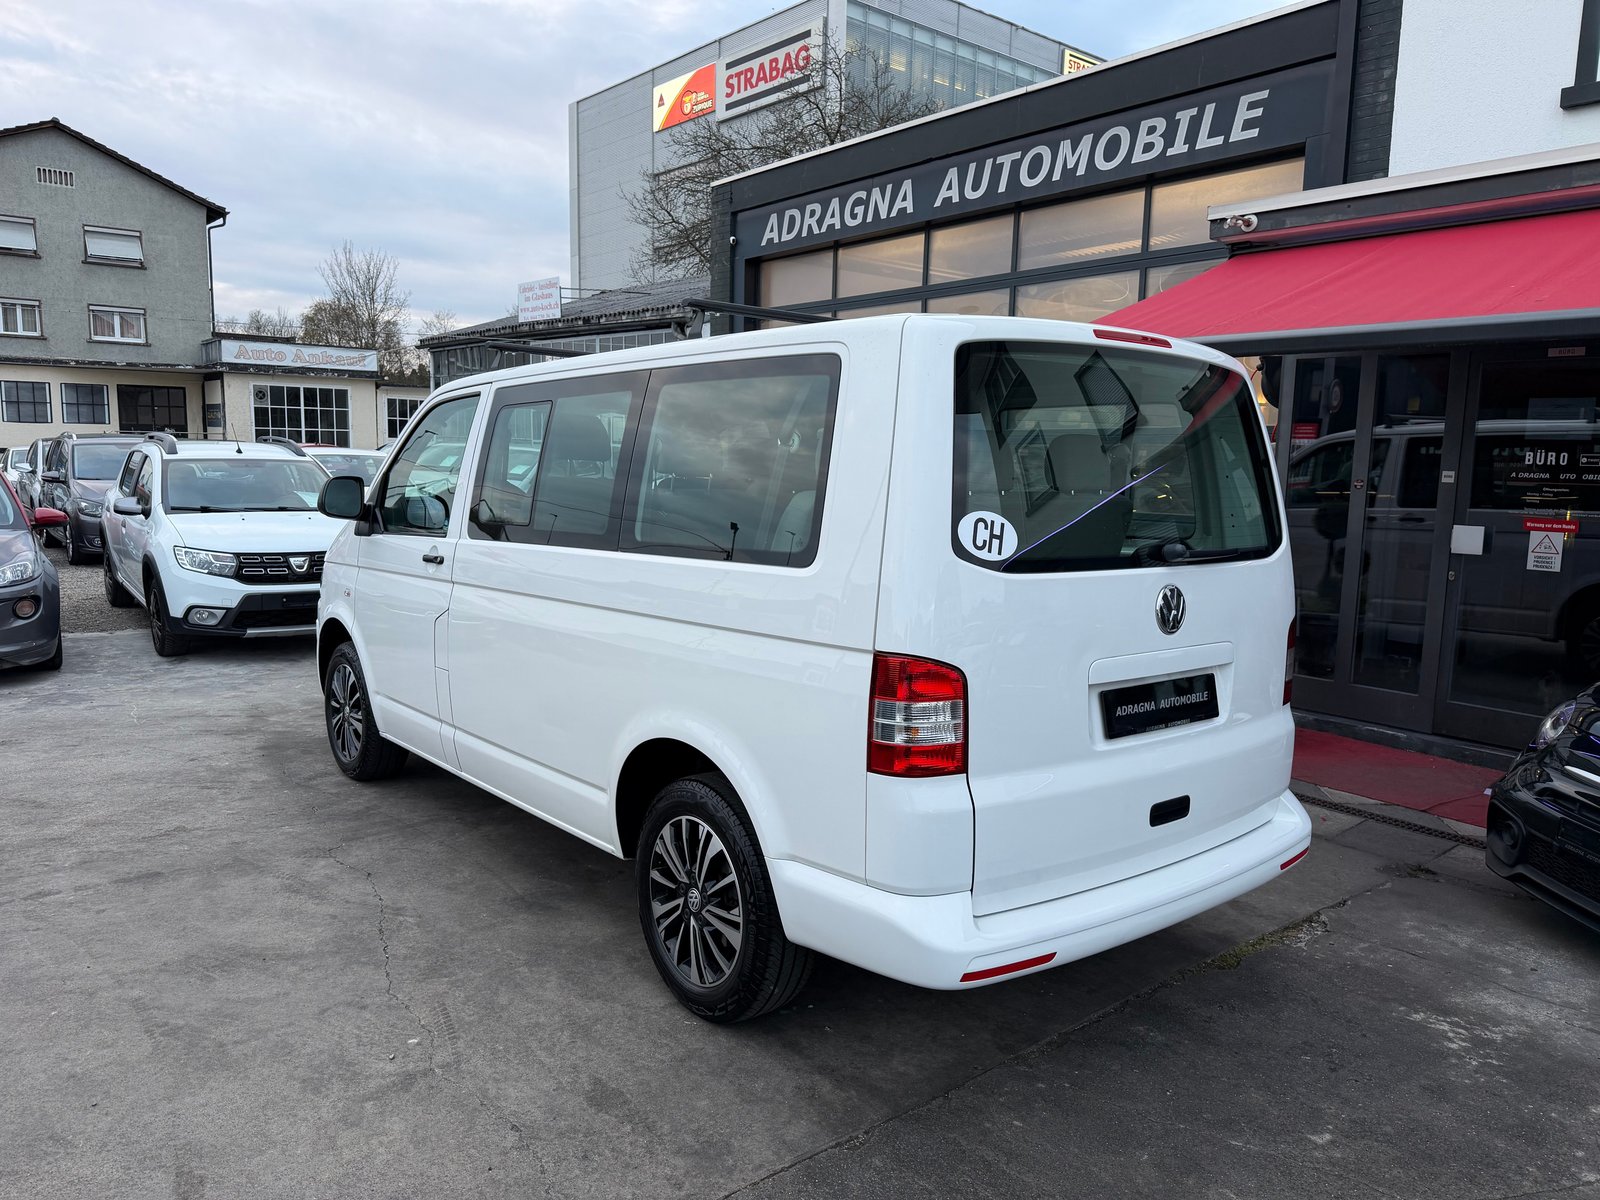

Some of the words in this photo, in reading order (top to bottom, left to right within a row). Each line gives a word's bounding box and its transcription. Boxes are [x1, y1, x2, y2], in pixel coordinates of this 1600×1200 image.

[725, 44, 810, 98] STRABAG
[1068, 59, 1090, 71] STRA
[761, 178, 914, 247] ADRAGNA
[934, 89, 1270, 209] AUTOMOBILE
[234, 344, 287, 362] Auto
[292, 349, 367, 367] Ankauf
[1525, 448, 1569, 466] BÜRO
[972, 517, 1005, 556] CH
[1116, 701, 1156, 717] ADRAGNA
[1159, 691, 1209, 709] AUTOMOBILE
